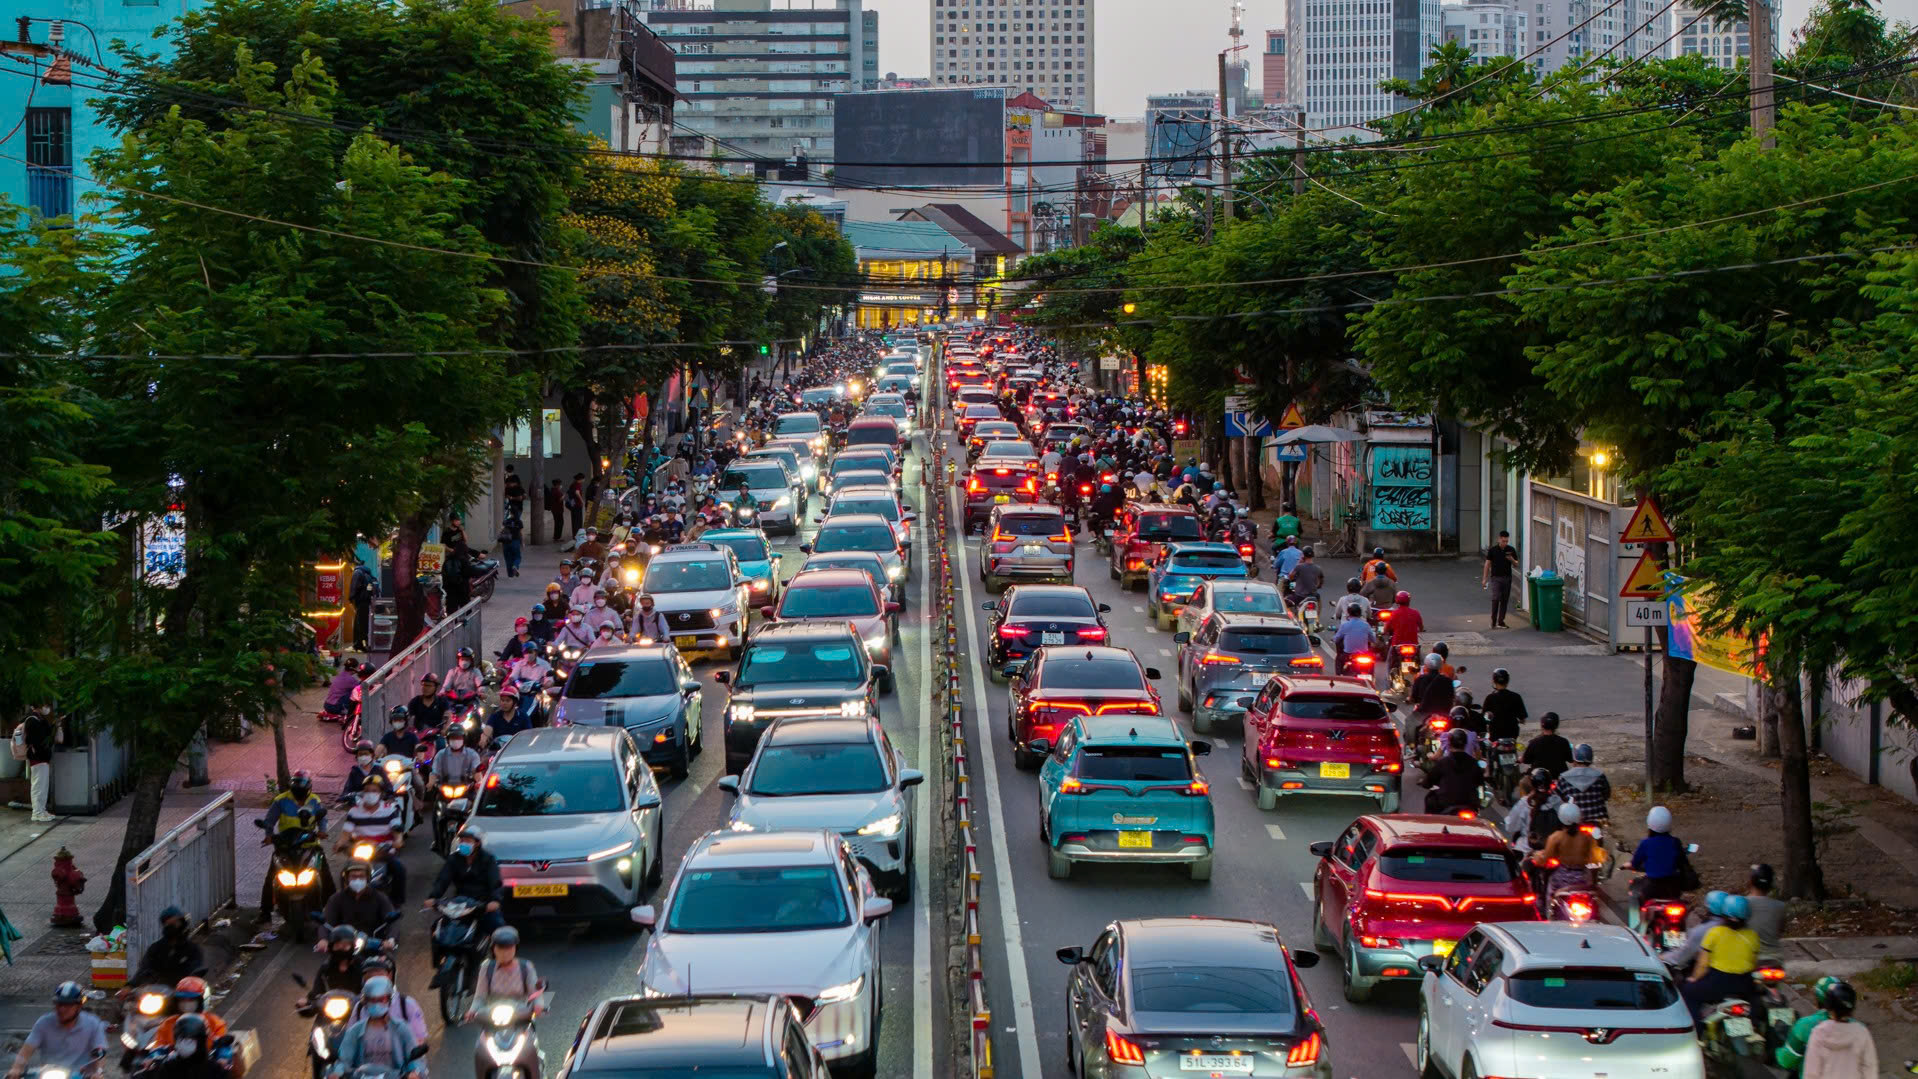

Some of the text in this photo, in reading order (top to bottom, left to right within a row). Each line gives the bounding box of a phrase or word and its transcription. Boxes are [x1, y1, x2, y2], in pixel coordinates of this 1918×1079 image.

[1636, 608, 1662, 620] 40 m
[1186, 1057, 1247, 1068] 51L-393.64
